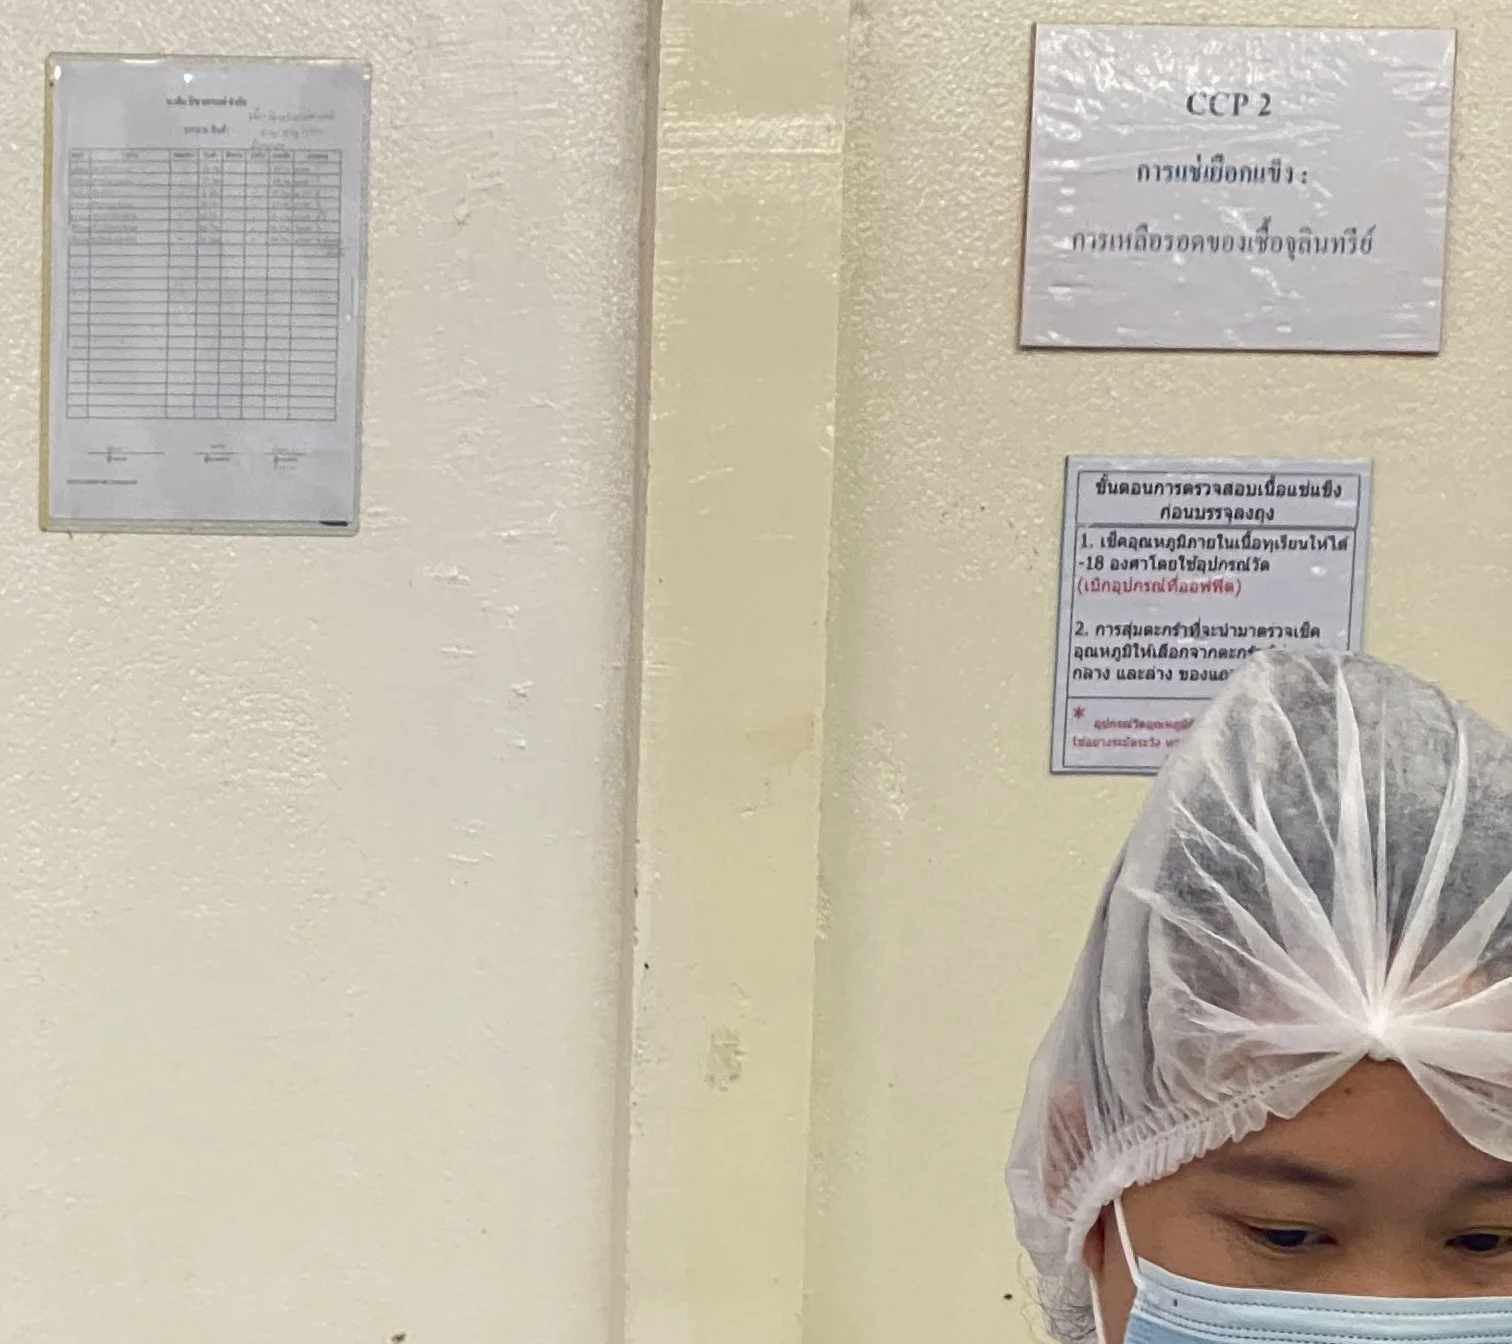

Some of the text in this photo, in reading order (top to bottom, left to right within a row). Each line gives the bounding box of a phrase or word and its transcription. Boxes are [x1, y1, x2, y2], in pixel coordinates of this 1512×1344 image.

[1186, 90, 1272, 118] CCP 2
[1082, 532, 1094, 548] 1.
[1078, 554, 1104, 571] -18
[1074, 620, 1089, 637] 2.
